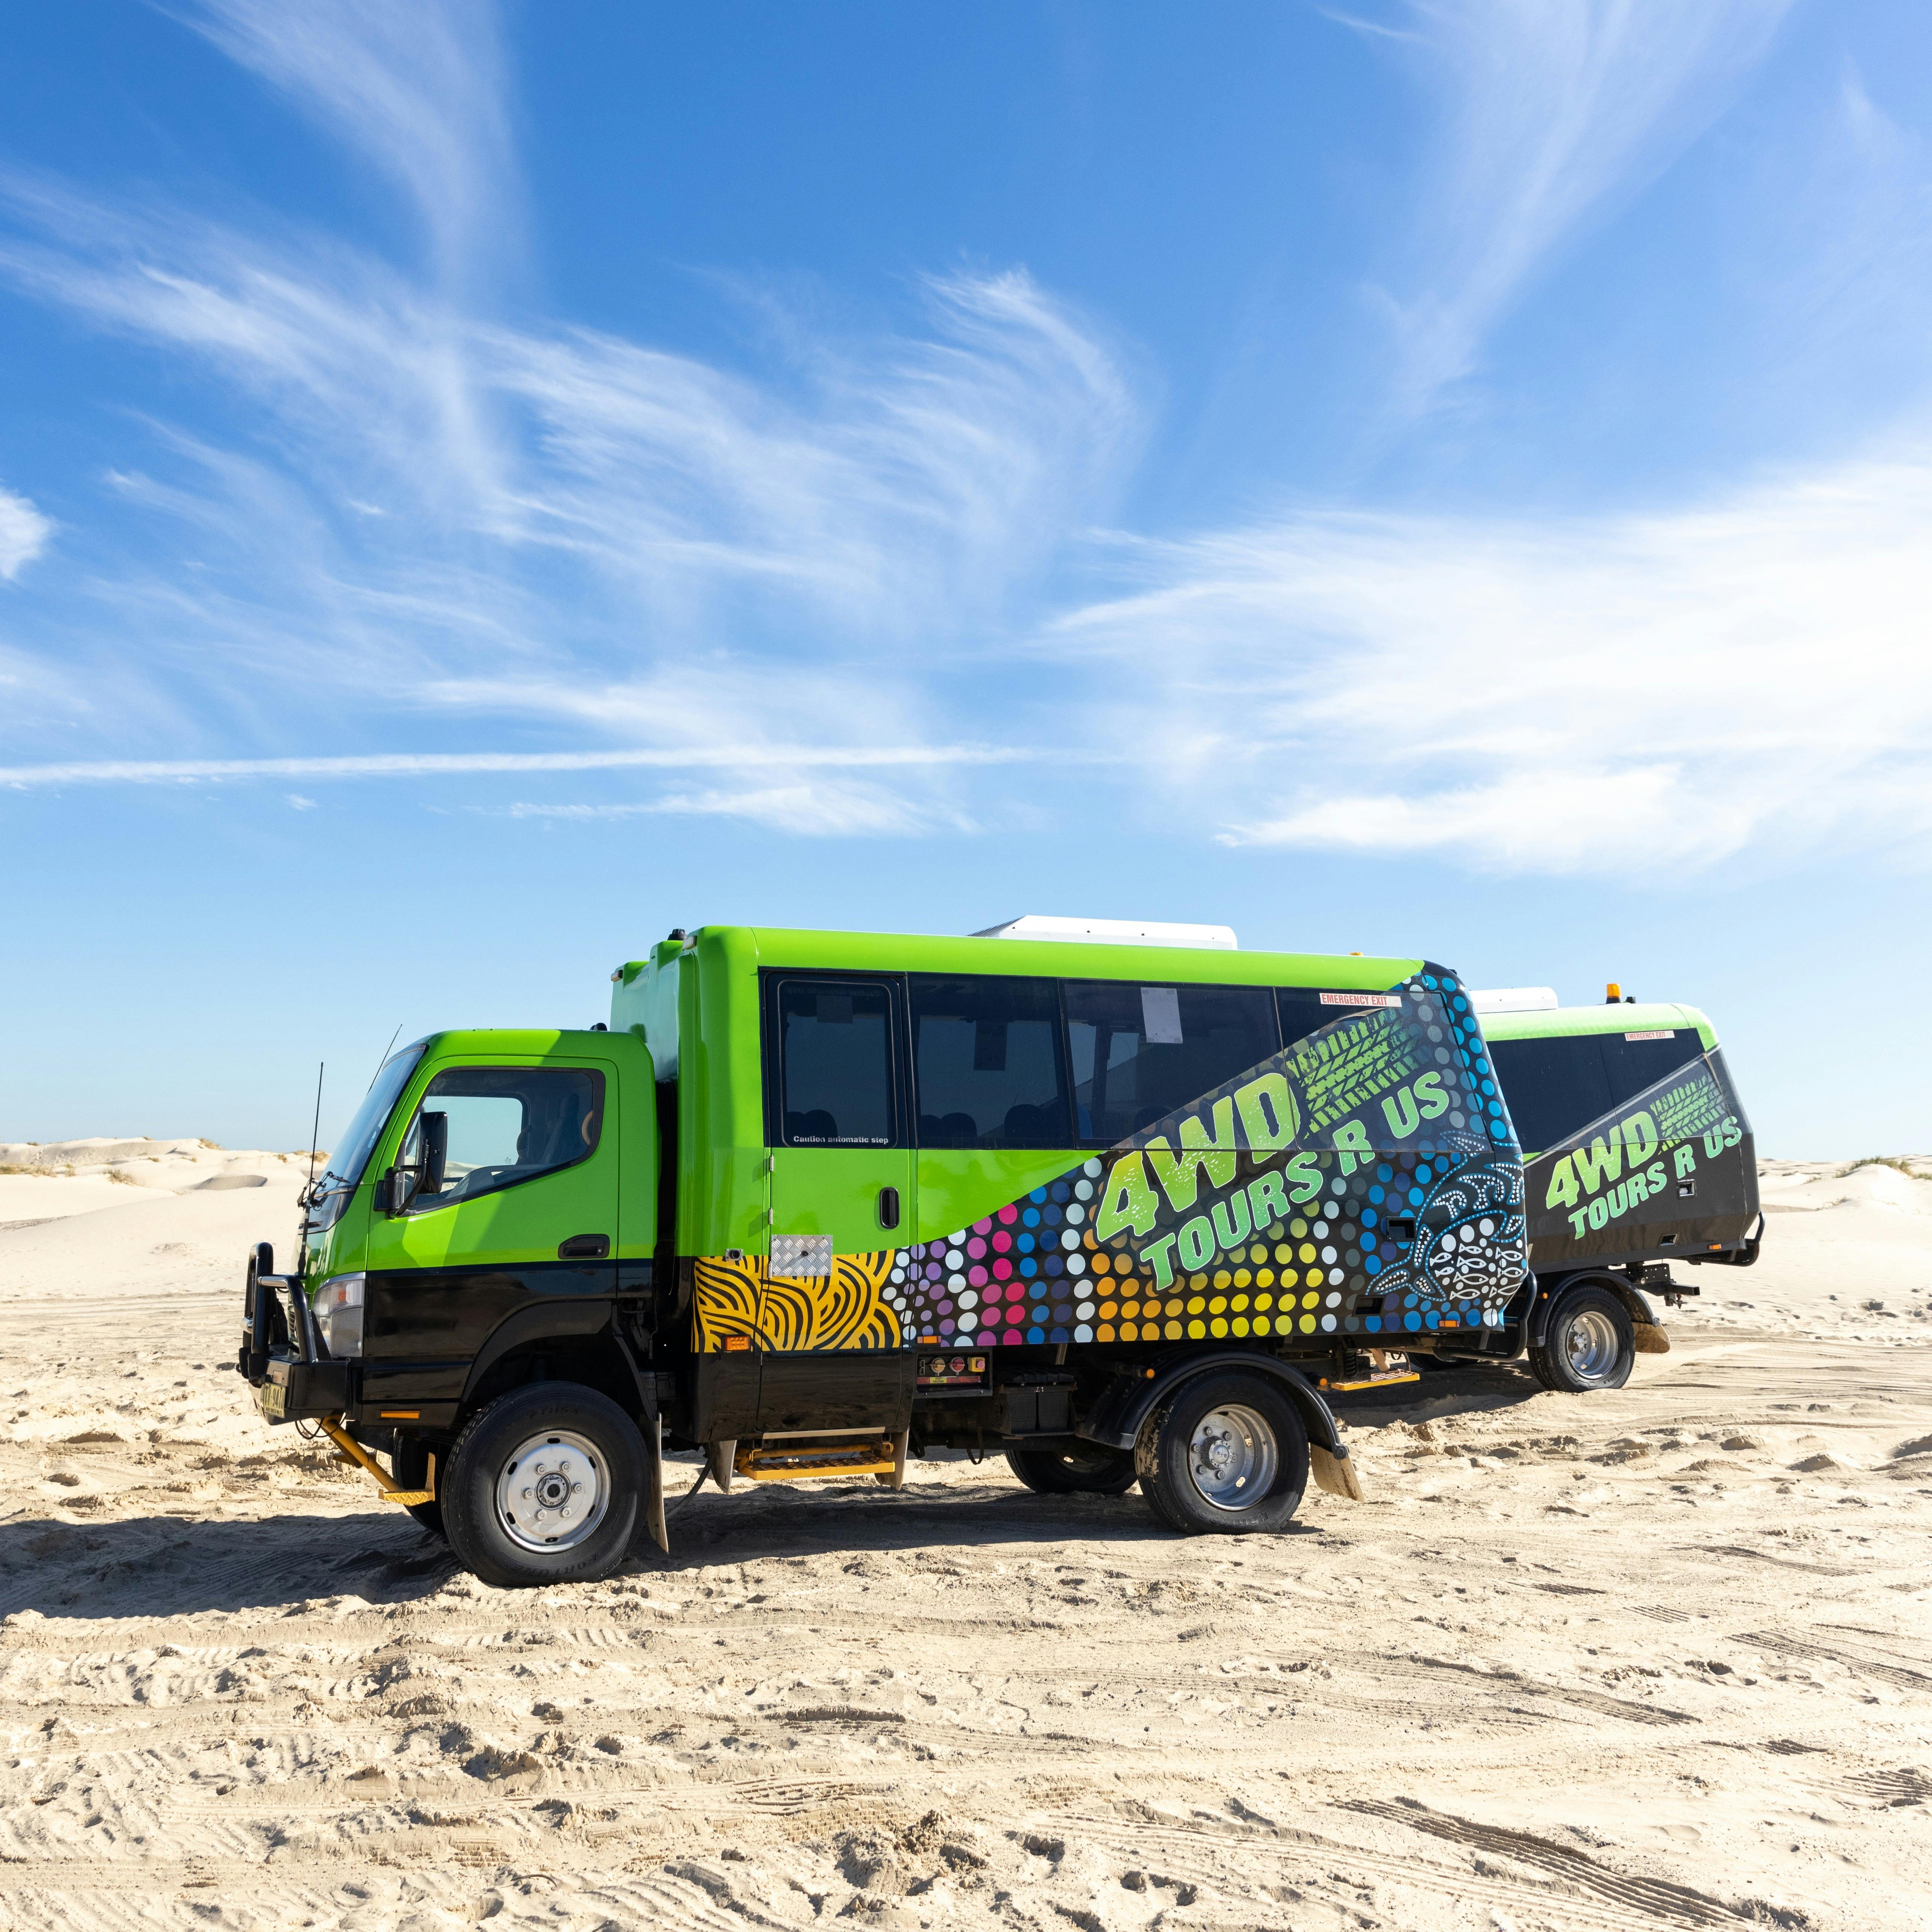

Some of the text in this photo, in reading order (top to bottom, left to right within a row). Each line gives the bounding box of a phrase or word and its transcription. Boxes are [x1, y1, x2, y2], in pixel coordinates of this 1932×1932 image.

[1321, 994, 1387, 1005] EMERGENCY EXIT
[1096, 1073, 1300, 1241] 4WD
[1140, 1072, 1449, 1290] TOURS R US
[1546, 1111, 1658, 1209] 4WD
[1568, 1116, 1742, 1239] TOURS R US
